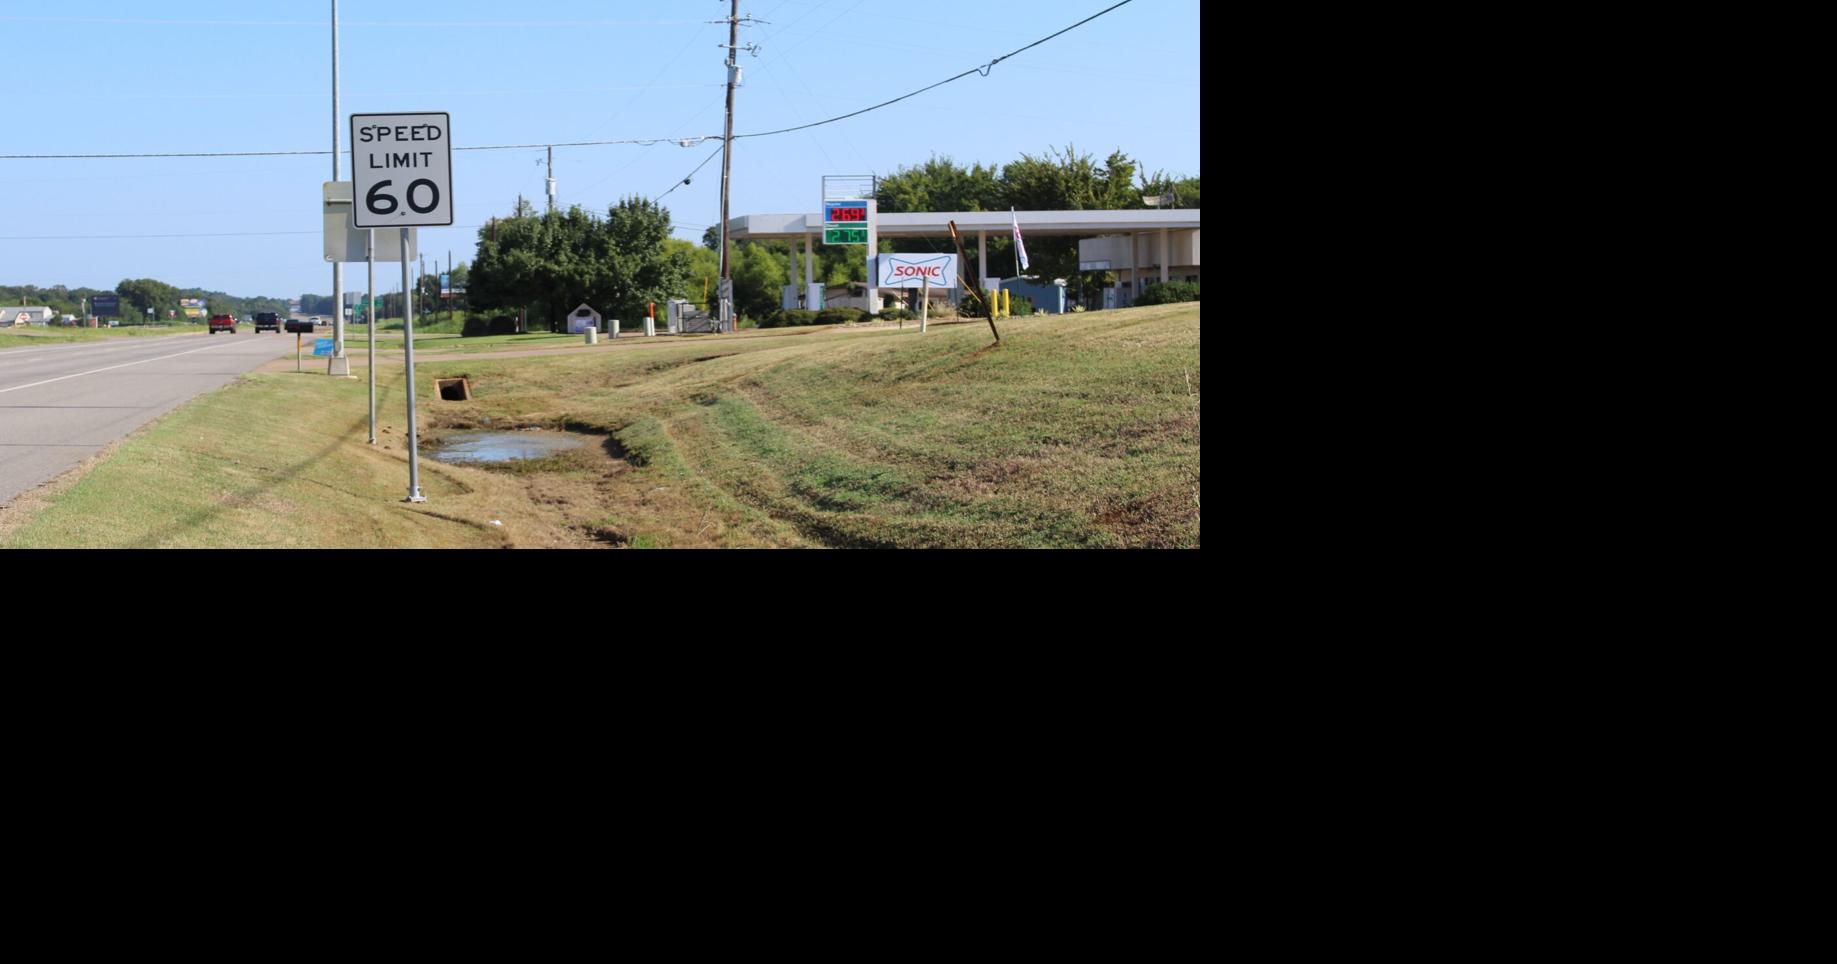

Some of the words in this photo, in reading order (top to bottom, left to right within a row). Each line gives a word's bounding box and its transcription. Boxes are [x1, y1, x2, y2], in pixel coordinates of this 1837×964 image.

[360, 125, 442, 142] SPEED
[369, 152, 433, 168] LIMIT
[365, 178, 440, 215] 60
[894, 265, 941, 277] SONIC
